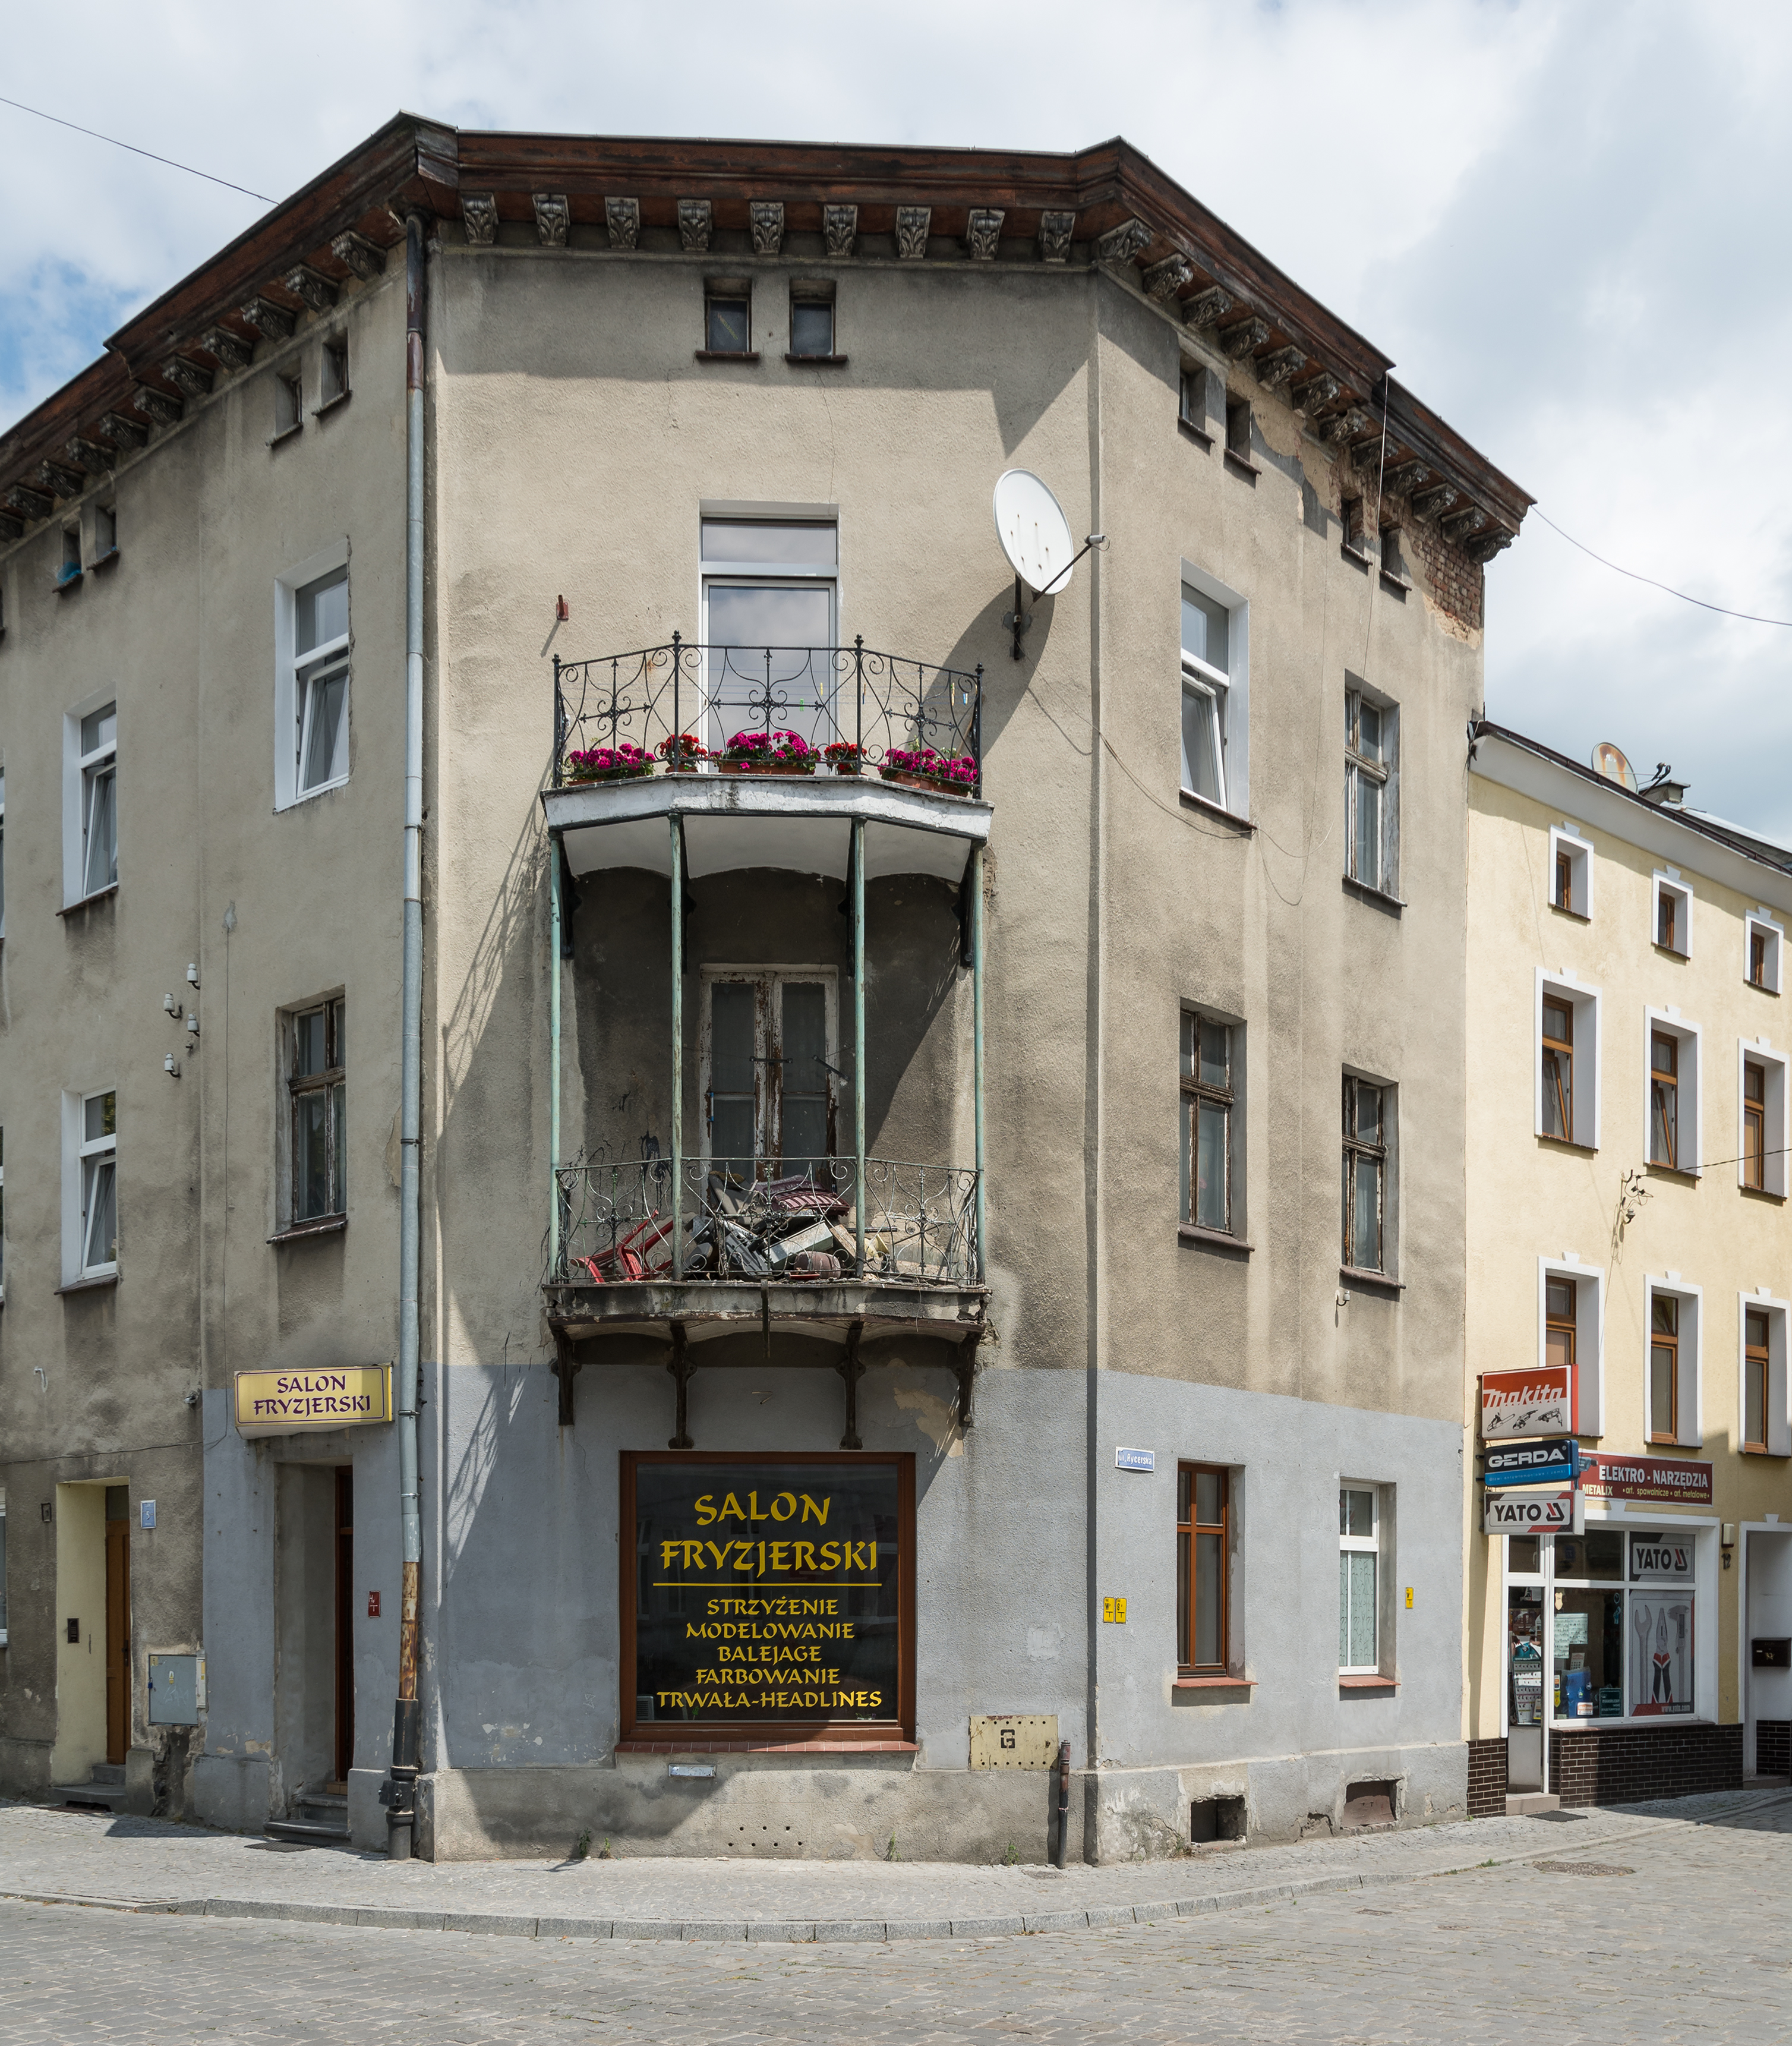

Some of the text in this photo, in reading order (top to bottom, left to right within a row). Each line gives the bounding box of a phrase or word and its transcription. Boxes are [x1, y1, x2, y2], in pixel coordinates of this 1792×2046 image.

[277, 1374, 346, 1394] SALON
[253, 1395, 371, 1417] FRYZJERSKI
[1127, 1454, 1152, 1465] Rycerska
[1488, 1448, 1565, 1468] GERDA
[1599, 1465, 1645, 1483] ELEKTRO
[1653, 1470, 1708, 1490] NARZĘDZIA
[1582, 1484, 1613, 1496] METALIX
[1637, 1487, 1669, 1497] spawalnicze
[1683, 1490, 1707, 1499] metalowe
[694, 1490, 831, 1525] SALON
[1494, 1504, 1541, 1521] YATO
[660, 1540, 877, 1578] FRYZJERSKI
[1636, 1548, 1671, 1570] YATO
[707, 1596, 838, 1615] STRZYŻENIE
[686, 1622, 855, 1639] MODELOWANIE
[717, 1645, 822, 1666] BALEJAGE
[696, 1668, 840, 1685] FARBOWANIE
[657, 1691, 882, 1708] TRWAŁA-HEADLINES
